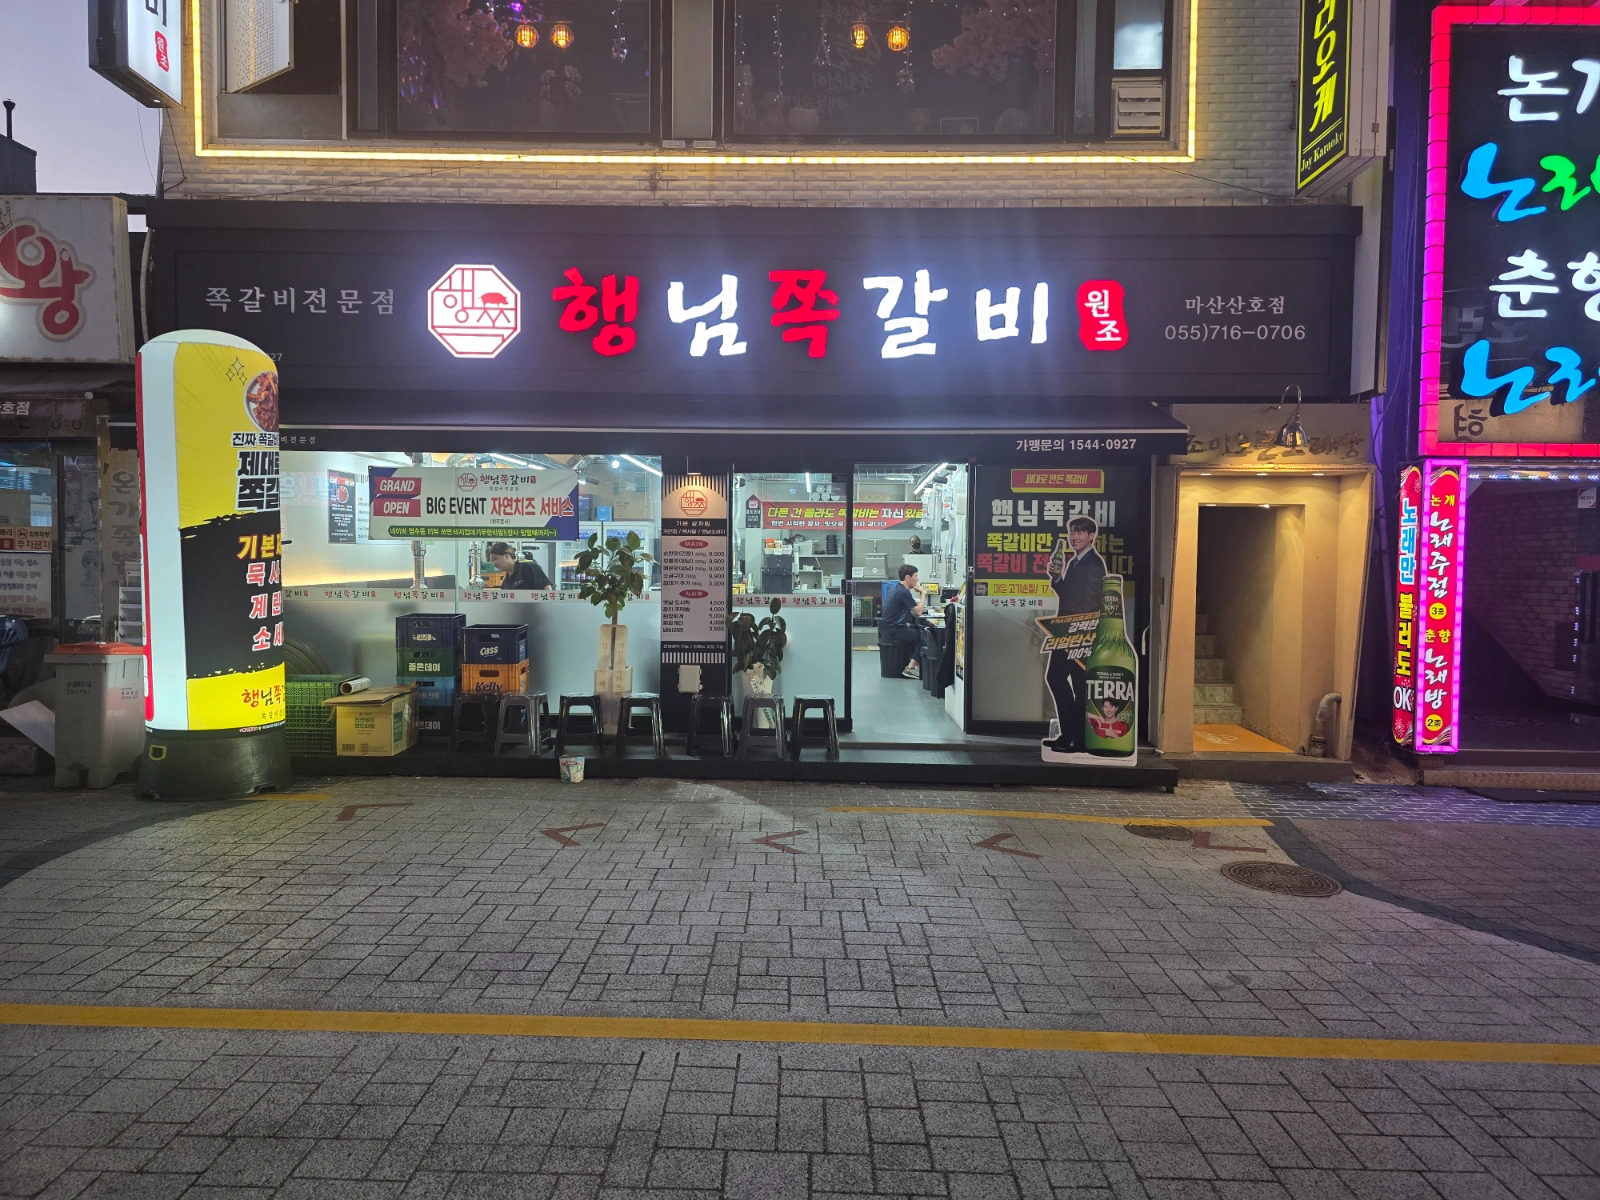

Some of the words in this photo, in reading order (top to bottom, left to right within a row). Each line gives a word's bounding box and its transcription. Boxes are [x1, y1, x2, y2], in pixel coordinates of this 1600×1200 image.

[1301, 155, 1313, 172] Joy
[1313, 131, 1344, 163] Karaoke
[205, 286, 396, 316] 쪽갈비전문점
[1185, 296, 1286, 316] 마산산호점
[552, 266, 1048, 359] 행님쪽갈비
[1084, 289, 1123, 342] 원조
[1164, 324, 1306, 343] 055)716-0706
[232, 432, 256, 447] 진짜
[1015, 437, 1065, 452] 가맹문의
[1069, 438, 1137, 451] 1544-0927
[379, 479, 416, 494] GRAND
[479, 474, 529, 486] 행님쪽갈비
[1025, 474, 1049, 484] 제대로
[1049, 474, 1064, 484] 만든
[1065, 474, 1088, 485] 쪽갈비
[426, 497, 446, 515] BIG
[449, 497, 487, 515] EVENT
[490, 496, 536, 517] 자연치즈
[540, 497, 575, 518] 서비스
[1430, 494, 1456, 507] 논개
[383, 501, 411, 515] OPEN
[767, 507, 789, 518] 다른
[790, 507, 803, 518] 건
[881, 508, 904, 519] 자신
[427, 528, 439, 536] 리뷰
[17, 541, 51, 550] 주차금지
[986, 532, 1053, 553] 쪽갈비만
[1427, 511, 1453, 599] 노래주점
[976, 552, 1026, 574] 쪽갈비
[324, 589, 370, 599] 행님쪽갈비
[393, 590, 438, 599] 행님쪽갈비
[464, 591, 509, 600] 행님쪽갈비
[994, 583, 1008, 594] 매일
[1009, 583, 1039, 594] 고기손질!
[793, 596, 837, 605] 행님쪽갈비
[991, 599, 1037, 607] 행님쪽갈비
[1431, 607, 1445, 616] 3층
[1068, 619, 1100, 633] 강력한
[1045, 632, 1097, 650] 리얼탄산
[1425, 629, 1451, 643] 춘향
[480, 646, 499, 658] Cass
[1067, 646, 1093, 660] 100%
[408, 662, 441, 672] 좋은데이
[1424, 648, 1448, 710] 노래방
[475, 681, 504, 693] Kelly
[1085, 680, 1134, 702] TERRA
[1393, 686, 1412, 711] OK
[1427, 719, 1442, 727] 2층
